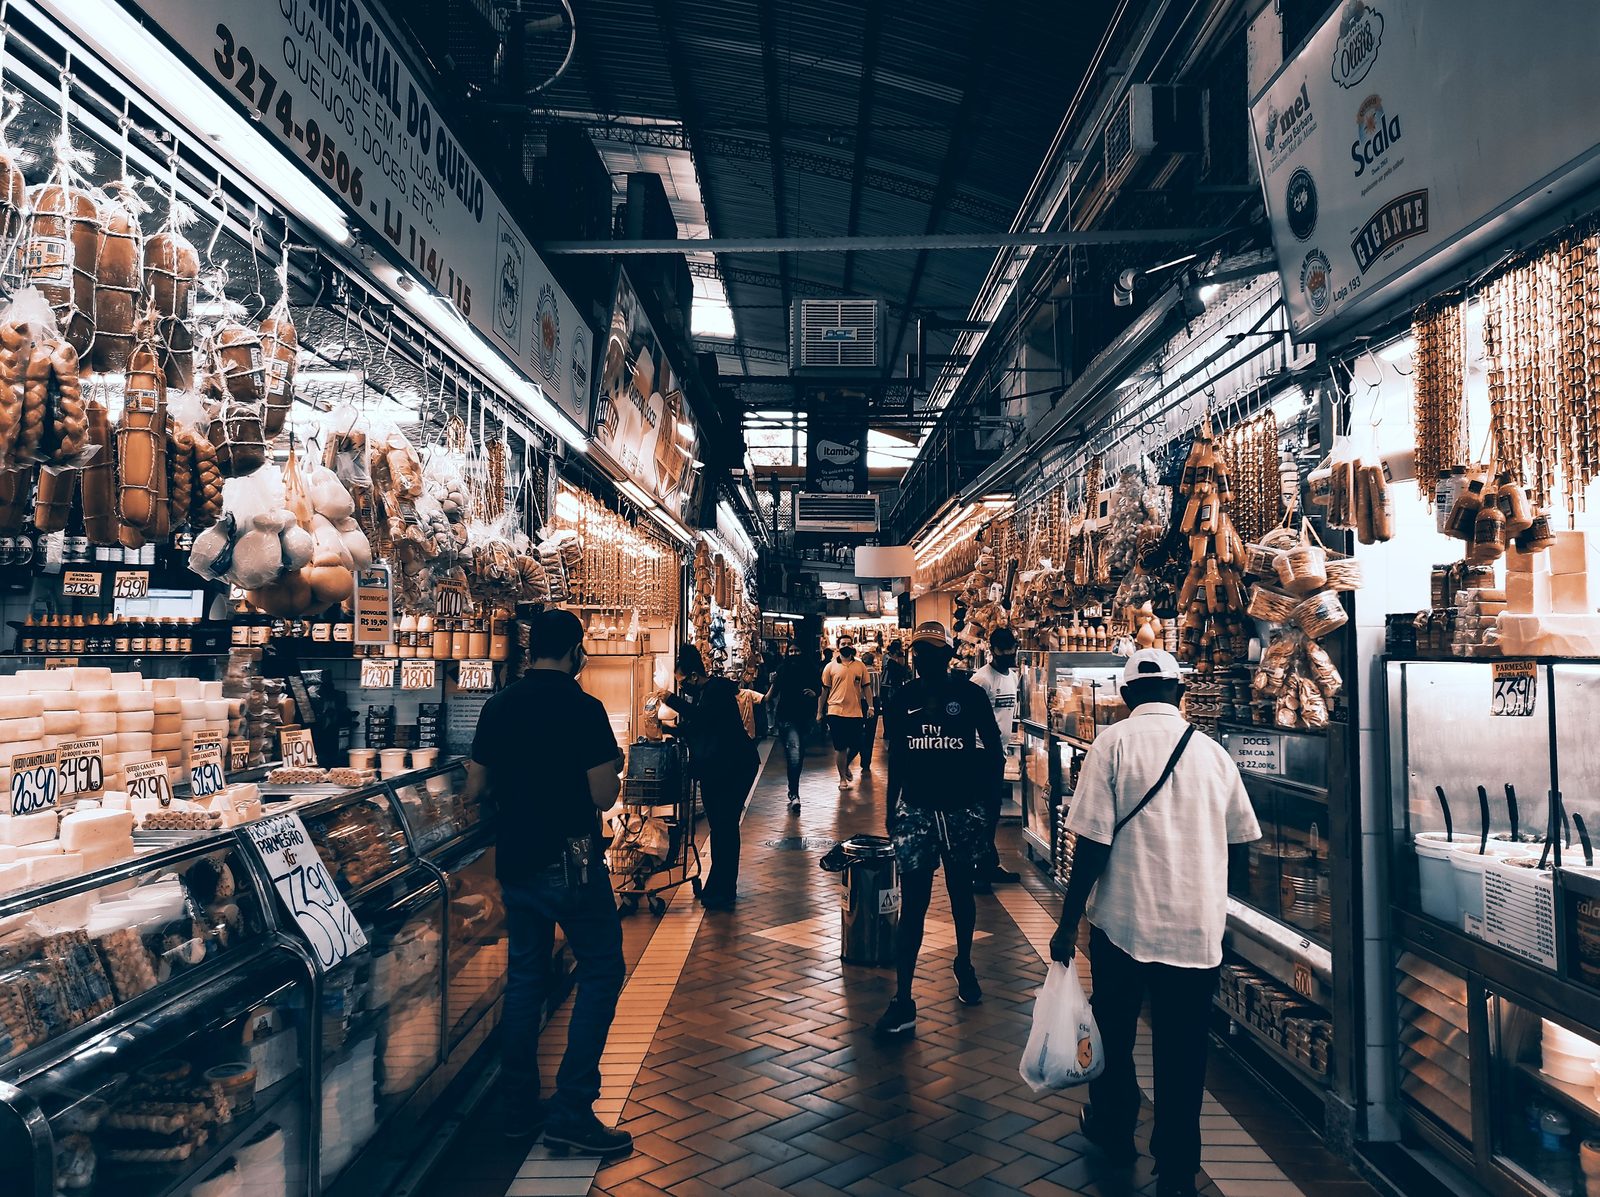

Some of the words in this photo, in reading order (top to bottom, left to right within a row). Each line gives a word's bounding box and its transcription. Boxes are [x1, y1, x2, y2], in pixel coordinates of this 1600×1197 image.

[280, 0, 371, 118] QUALIDADE
[375, 101, 393, 145] EM
[410, 146, 445, 208] LUGAR
[1280, 82, 1310, 136] mel
[213, 23, 363, 207] 3274-9506
[384, 198, 402, 246] LJ
[407, 79, 432, 155] DO
[436, 126, 483, 223] QUEIJO
[1351, 113, 1402, 177] Scala
[412, 183, 441, 236] ETC...
[1356, 199, 1424, 267] GIGANTE
[1333, 284, 1348, 302] Loja
[1349, 276, 1361, 293] 193
[360, 618, 370, 626] R$
[371, 618, 388, 627] 19,90
[1495, 661, 1533, 671] PARMESÃO
[74, 741, 100, 749] CANASTRA
[922, 724, 941, 737] Fly
[1243, 737, 1271, 746] DOCES
[140, 761, 164, 770] CANASTRA
[12, 766, 56, 815] 26,90
[256, 830, 304, 855] PARMESÃO
